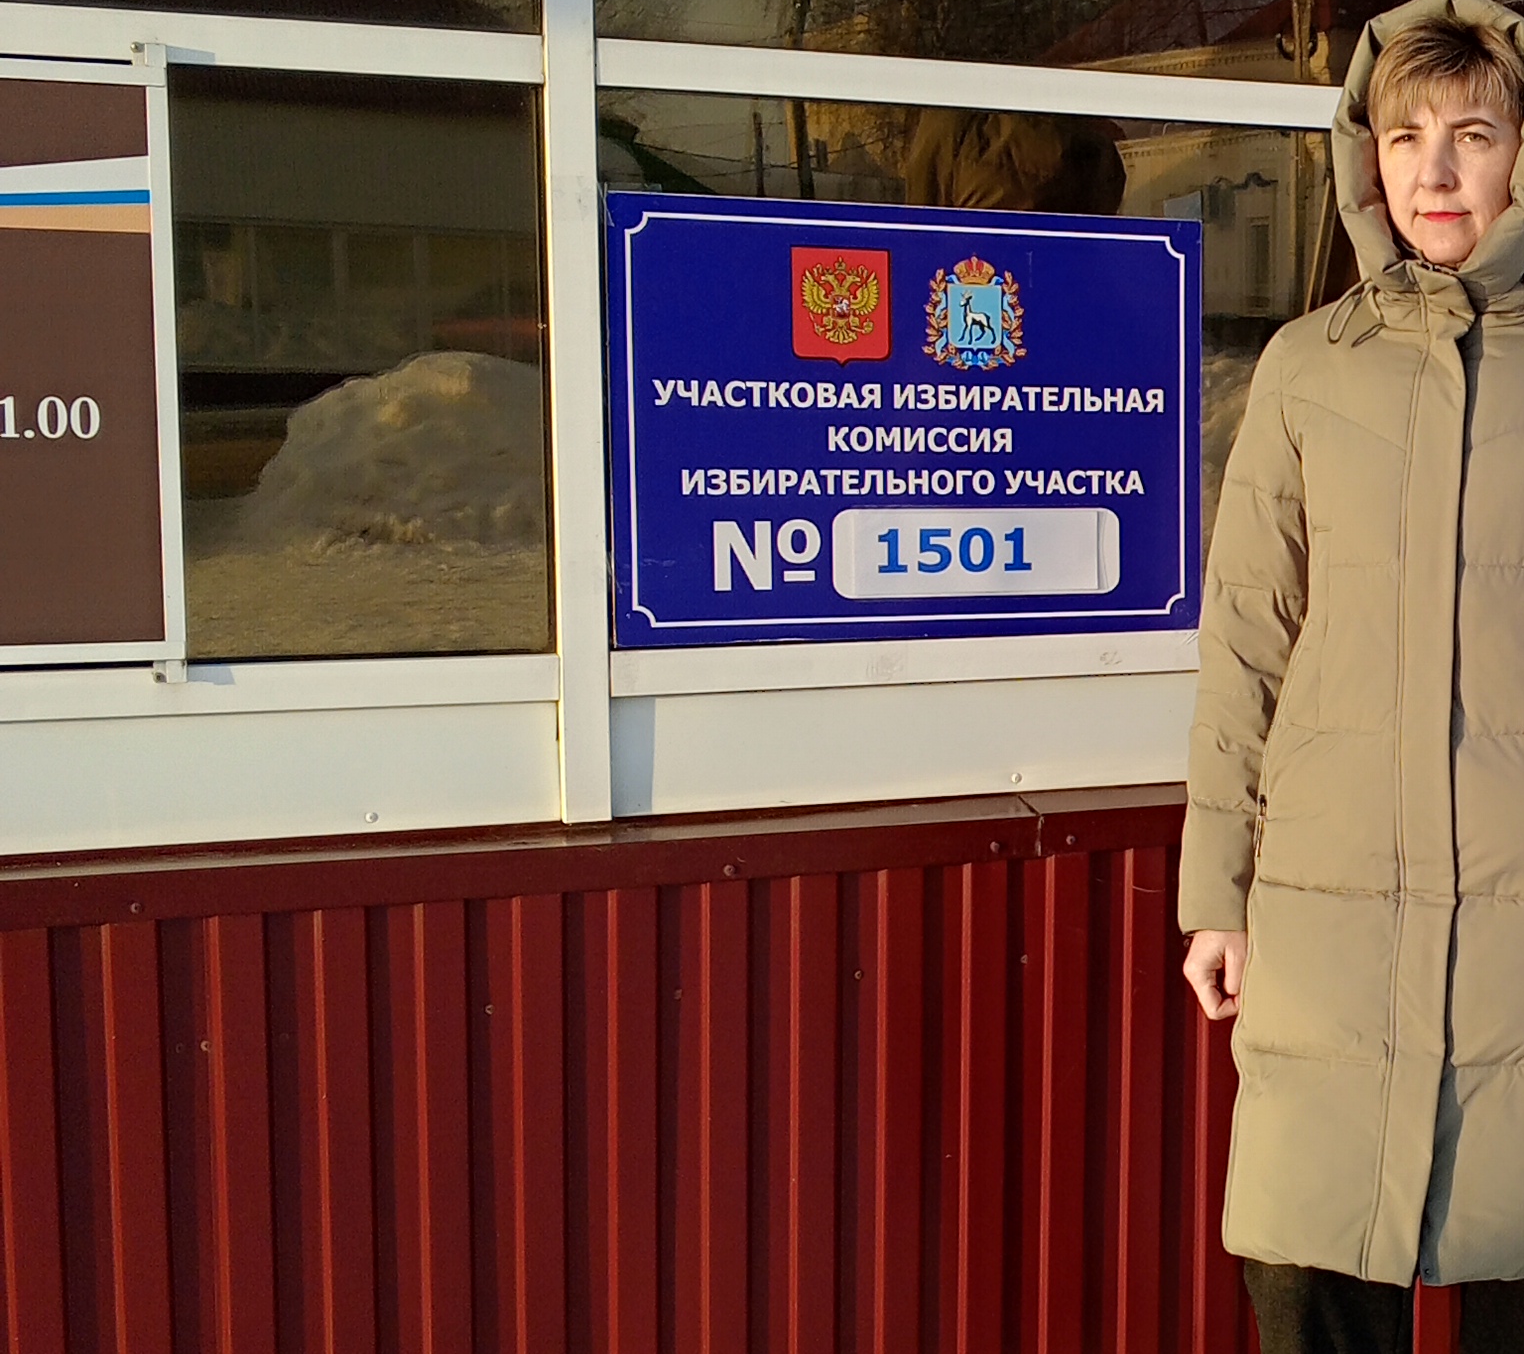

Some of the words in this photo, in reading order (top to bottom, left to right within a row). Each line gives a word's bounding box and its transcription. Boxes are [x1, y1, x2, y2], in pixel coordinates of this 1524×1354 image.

[652, 379, 882, 409] УЧАСТКОВАЯ
[893, 383, 1164, 413] ИЗБИРАТЕЛЬНАЯ
[828, 426, 1013, 453] КОМИССИЯ
[681, 468, 996, 496] ИЗБИРАТЕЛЬНОГО
[1003, 469, 1145, 495] УЧАСТКА
[877, 527, 1033, 574] 1501
